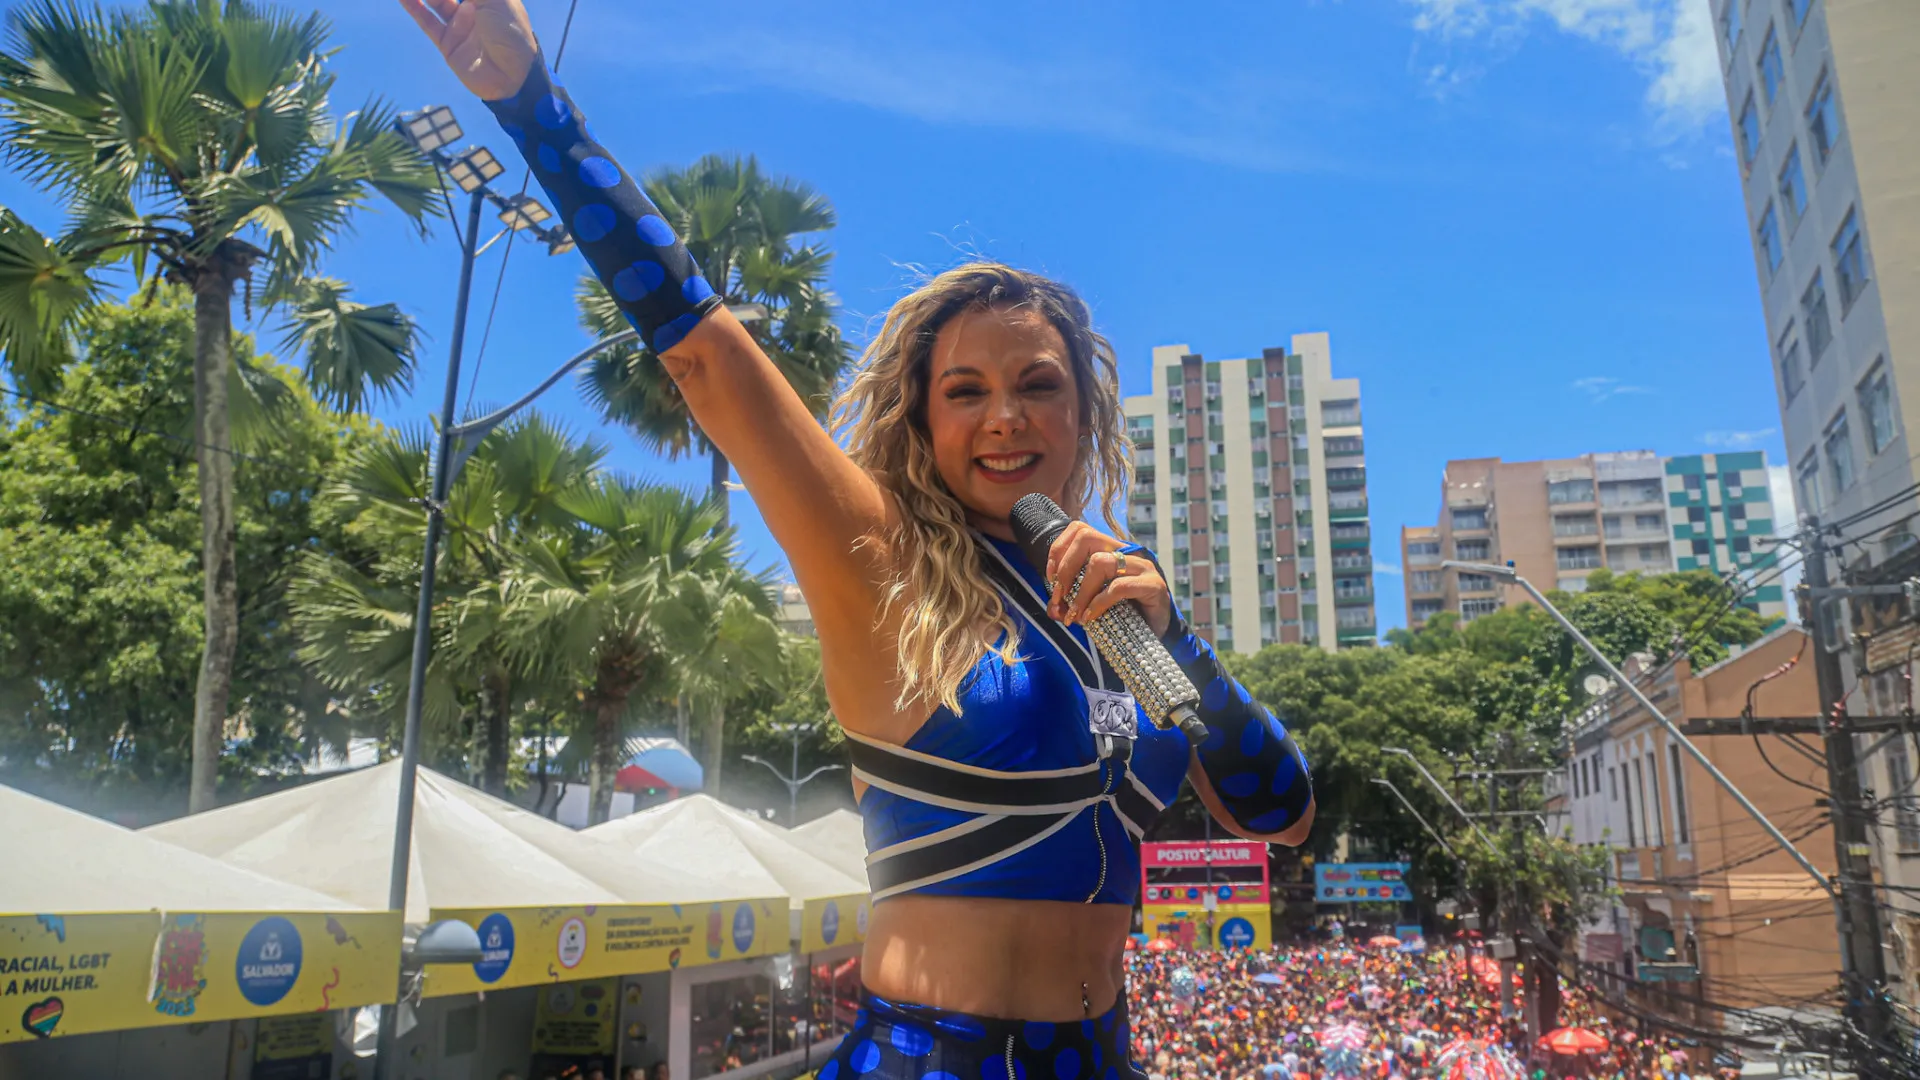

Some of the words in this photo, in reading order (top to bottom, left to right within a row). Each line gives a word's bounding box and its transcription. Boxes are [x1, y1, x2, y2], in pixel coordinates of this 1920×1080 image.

[1157, 849, 1200, 861] POSTO
[0, 956, 65, 974] RACIAL,
[69, 952, 112, 970] LGBT
[242, 963, 294, 978] SALVADOR
[22, 974, 99, 994] MULHER.
